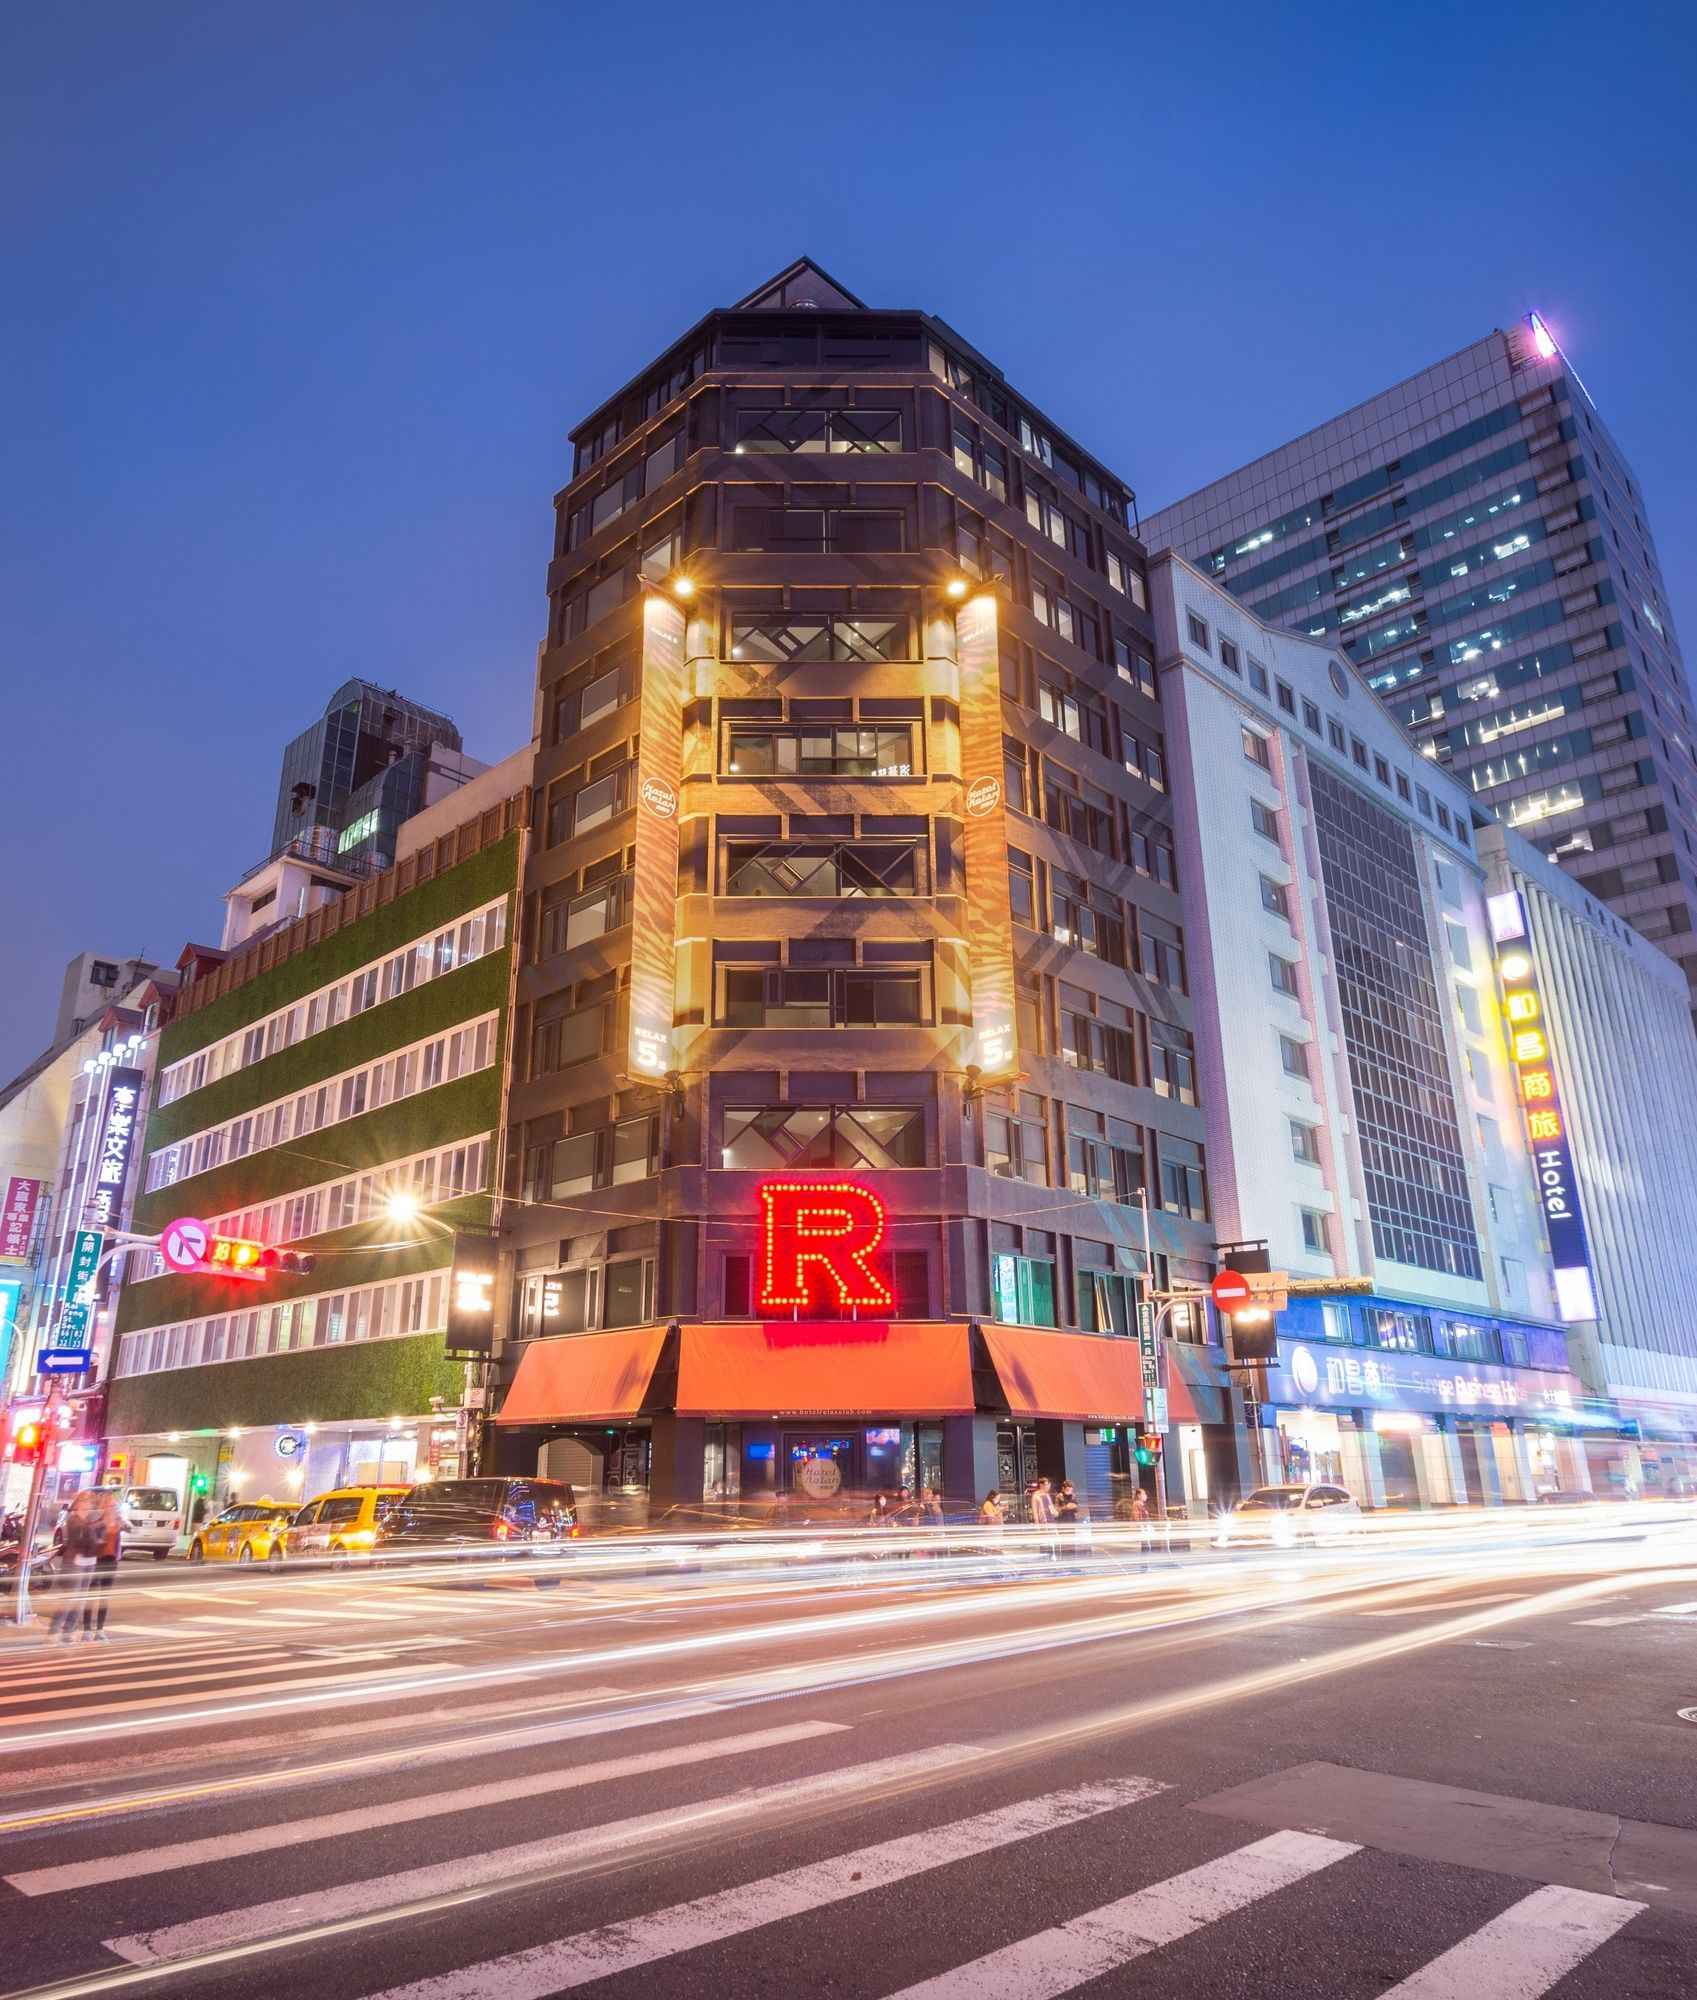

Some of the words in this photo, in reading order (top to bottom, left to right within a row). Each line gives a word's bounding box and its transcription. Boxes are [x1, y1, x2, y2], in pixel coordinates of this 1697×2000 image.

[645, 784, 673, 801] Hotel
[968, 782, 997, 799] Hotel
[635, 1027, 667, 1043] RELAX
[979, 1024, 1011, 1040] RELAX
[637, 1040, 657, 1066] 5
[984, 1038, 1003, 1064] 5
[1507, 992, 1560, 1141] 和昌商旅
[1539, 1150, 1571, 1219] Hotel
[760, 1182, 892, 1308] R
[63, 1310, 83, 1318] Feng
[64, 1302, 78, 1310] Kai
[1455, 1375, 1501, 1400] Business
[805, 1467, 836, 1476] Hotel
